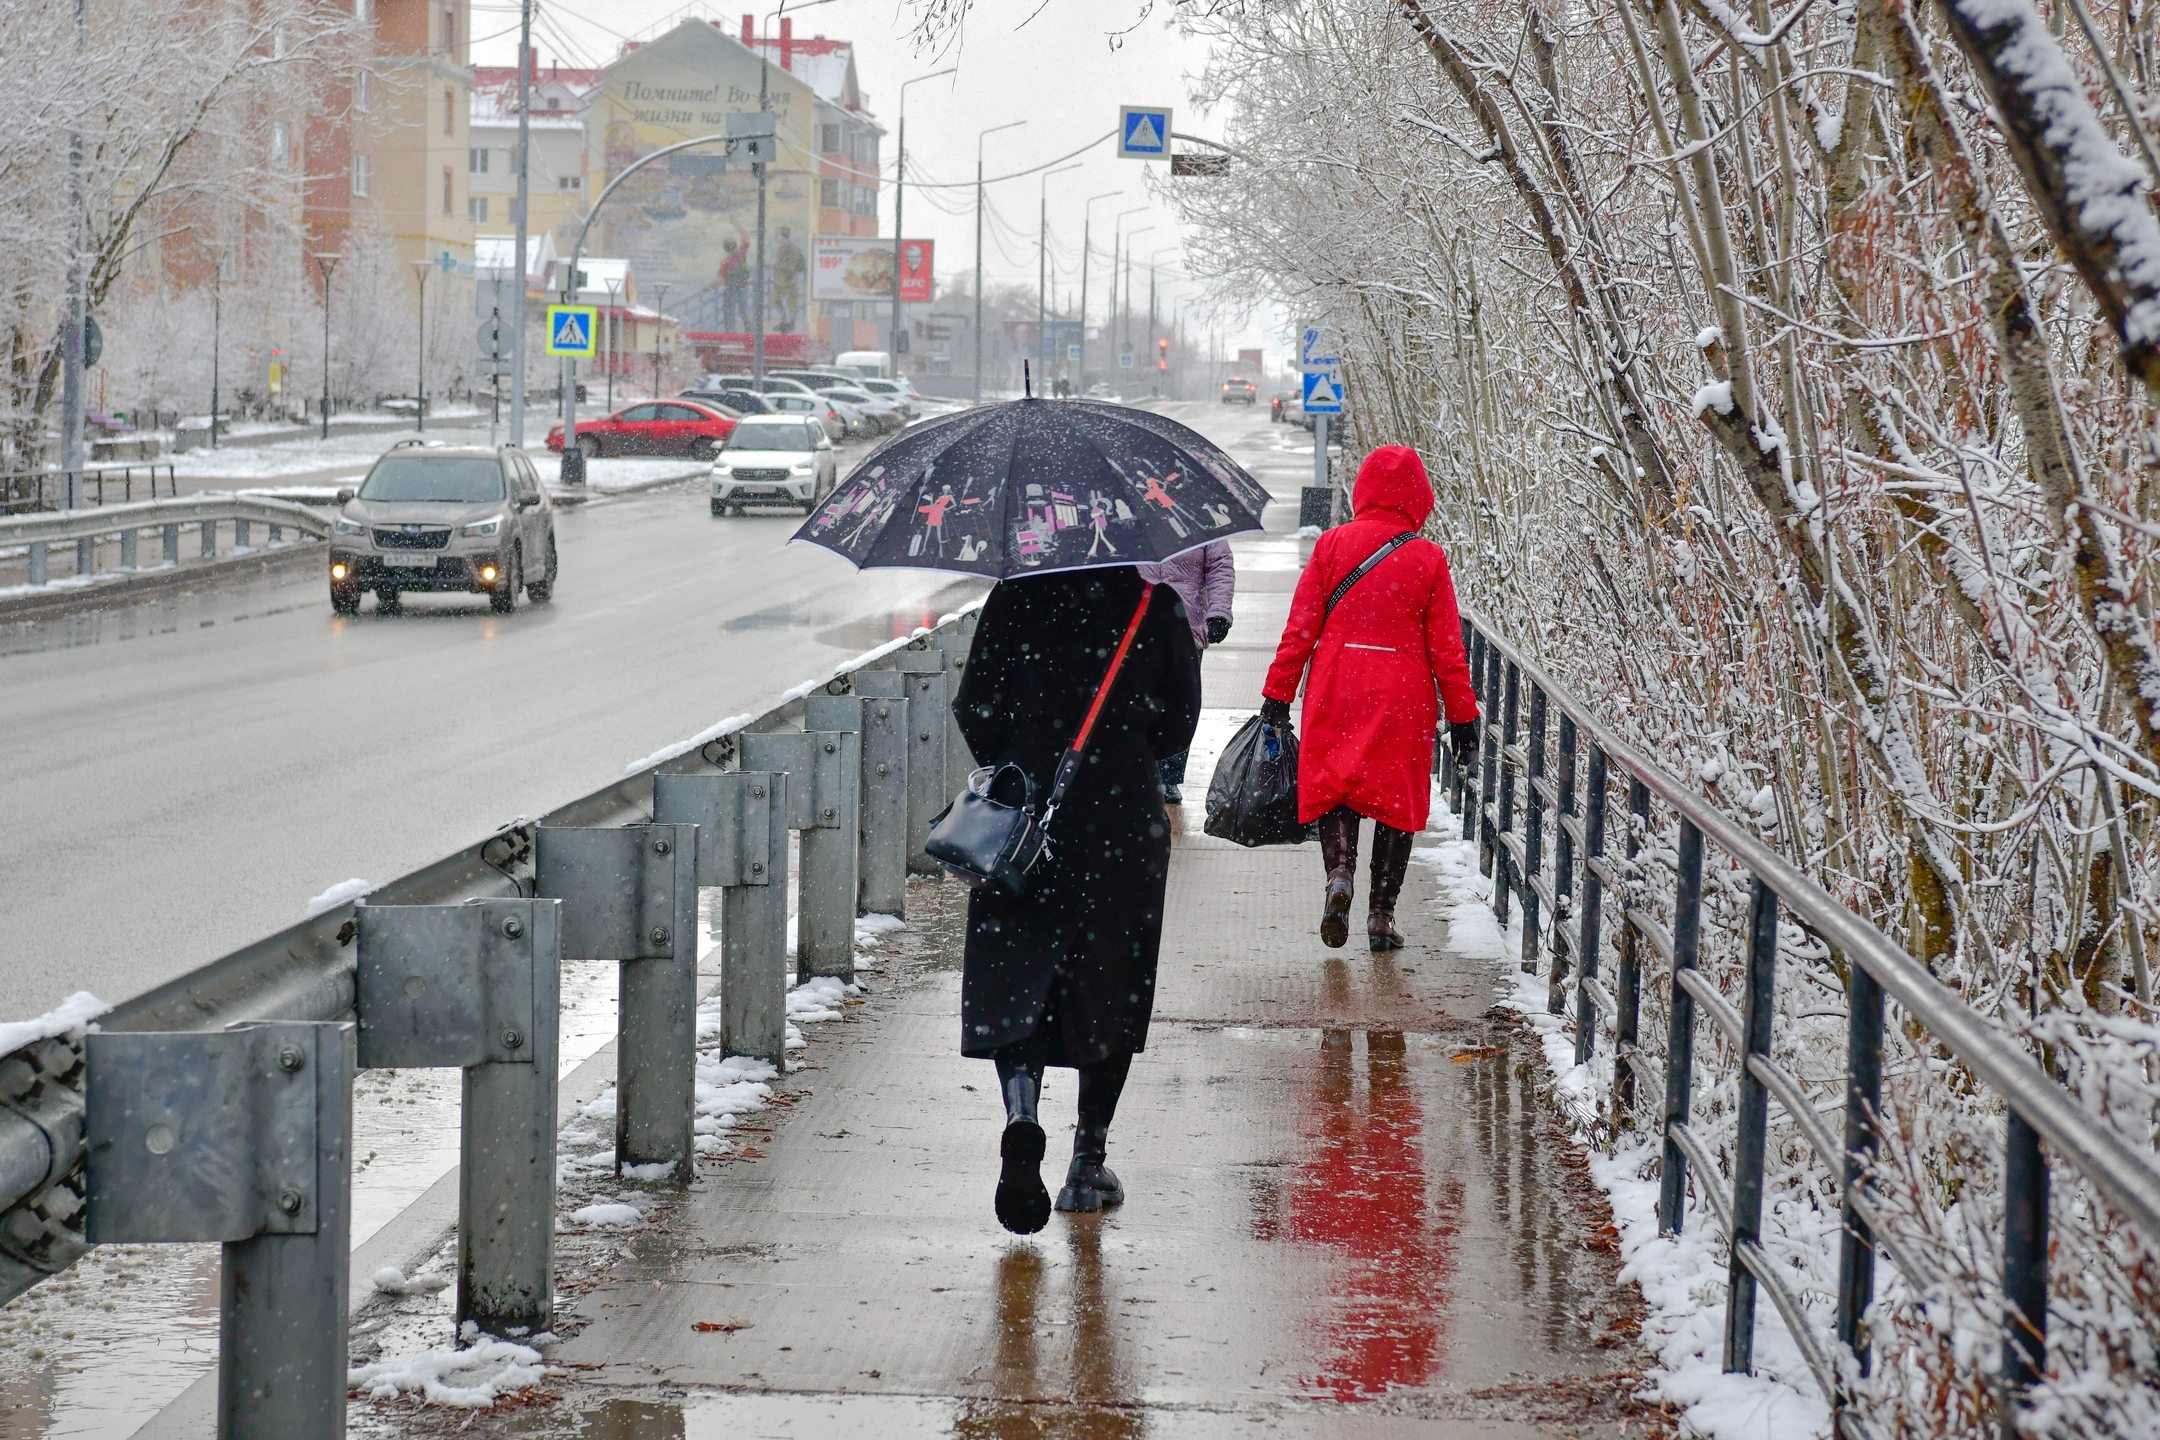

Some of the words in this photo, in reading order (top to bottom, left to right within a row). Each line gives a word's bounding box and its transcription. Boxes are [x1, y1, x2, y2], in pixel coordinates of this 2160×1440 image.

[624, 81, 719, 103] Помните!
[726, 85, 751, 104] Во
[758, 91, 792, 104] мя
[633, 108, 693, 124] жизни
[700, 110, 722, 124] на
[902, 278, 925, 288] KFC
